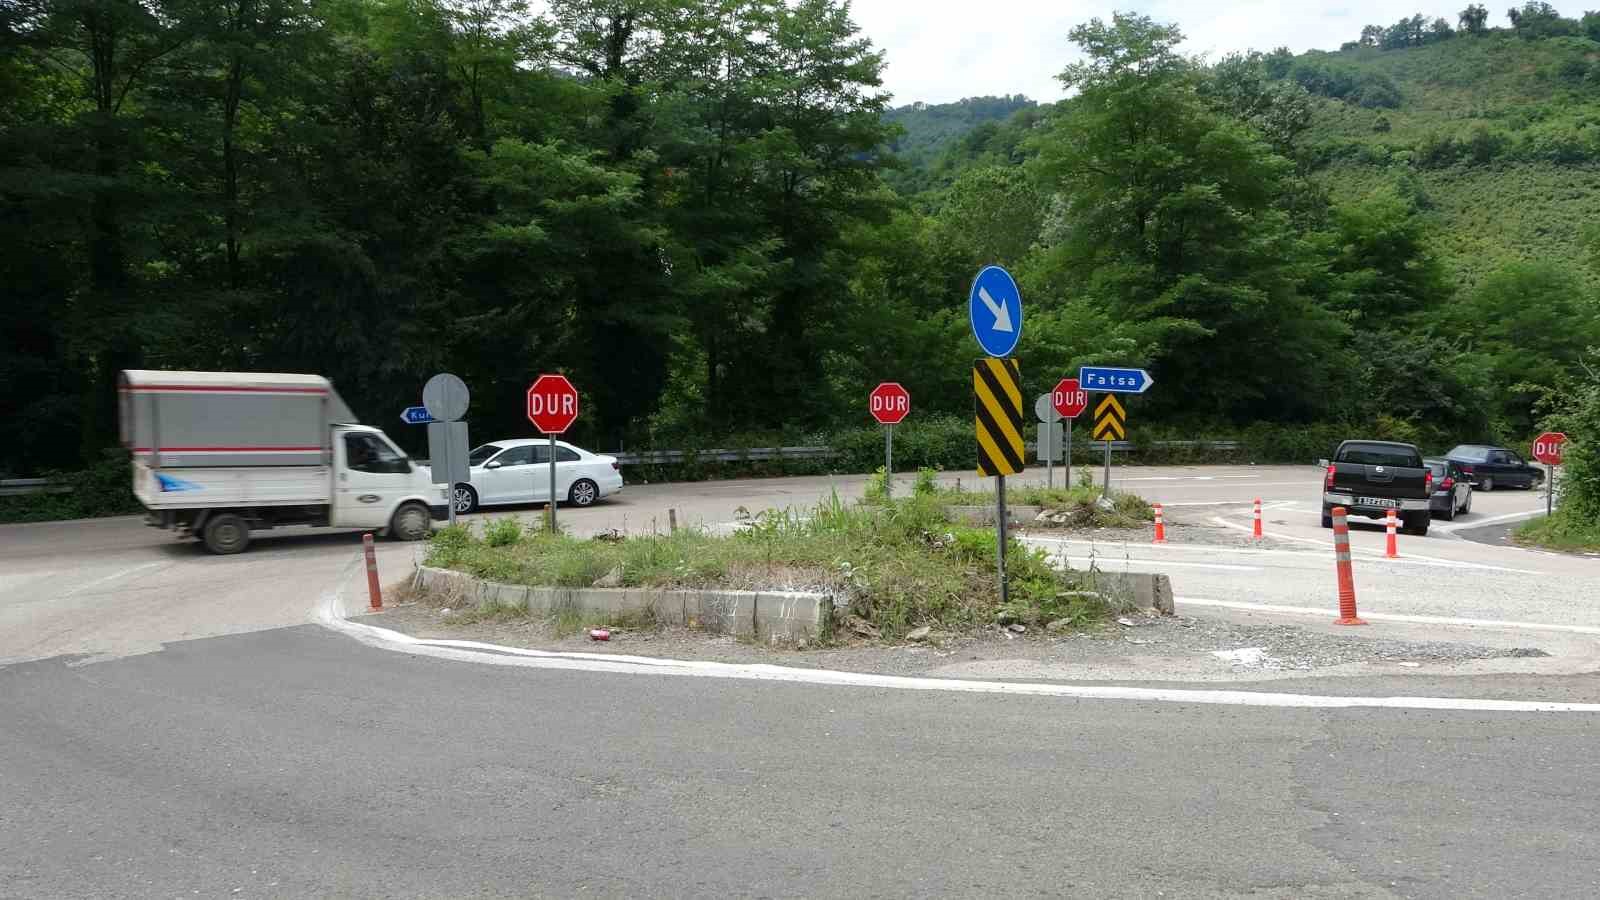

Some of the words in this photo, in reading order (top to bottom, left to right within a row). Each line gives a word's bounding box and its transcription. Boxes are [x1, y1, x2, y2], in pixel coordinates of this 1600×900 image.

[1087, 373, 1136, 386] Fatsa
[532, 393, 574, 415] DUR
[873, 395, 906, 411] DUR
[1055, 391, 1084, 406] DUR
[1536, 442, 1559, 456] DU
